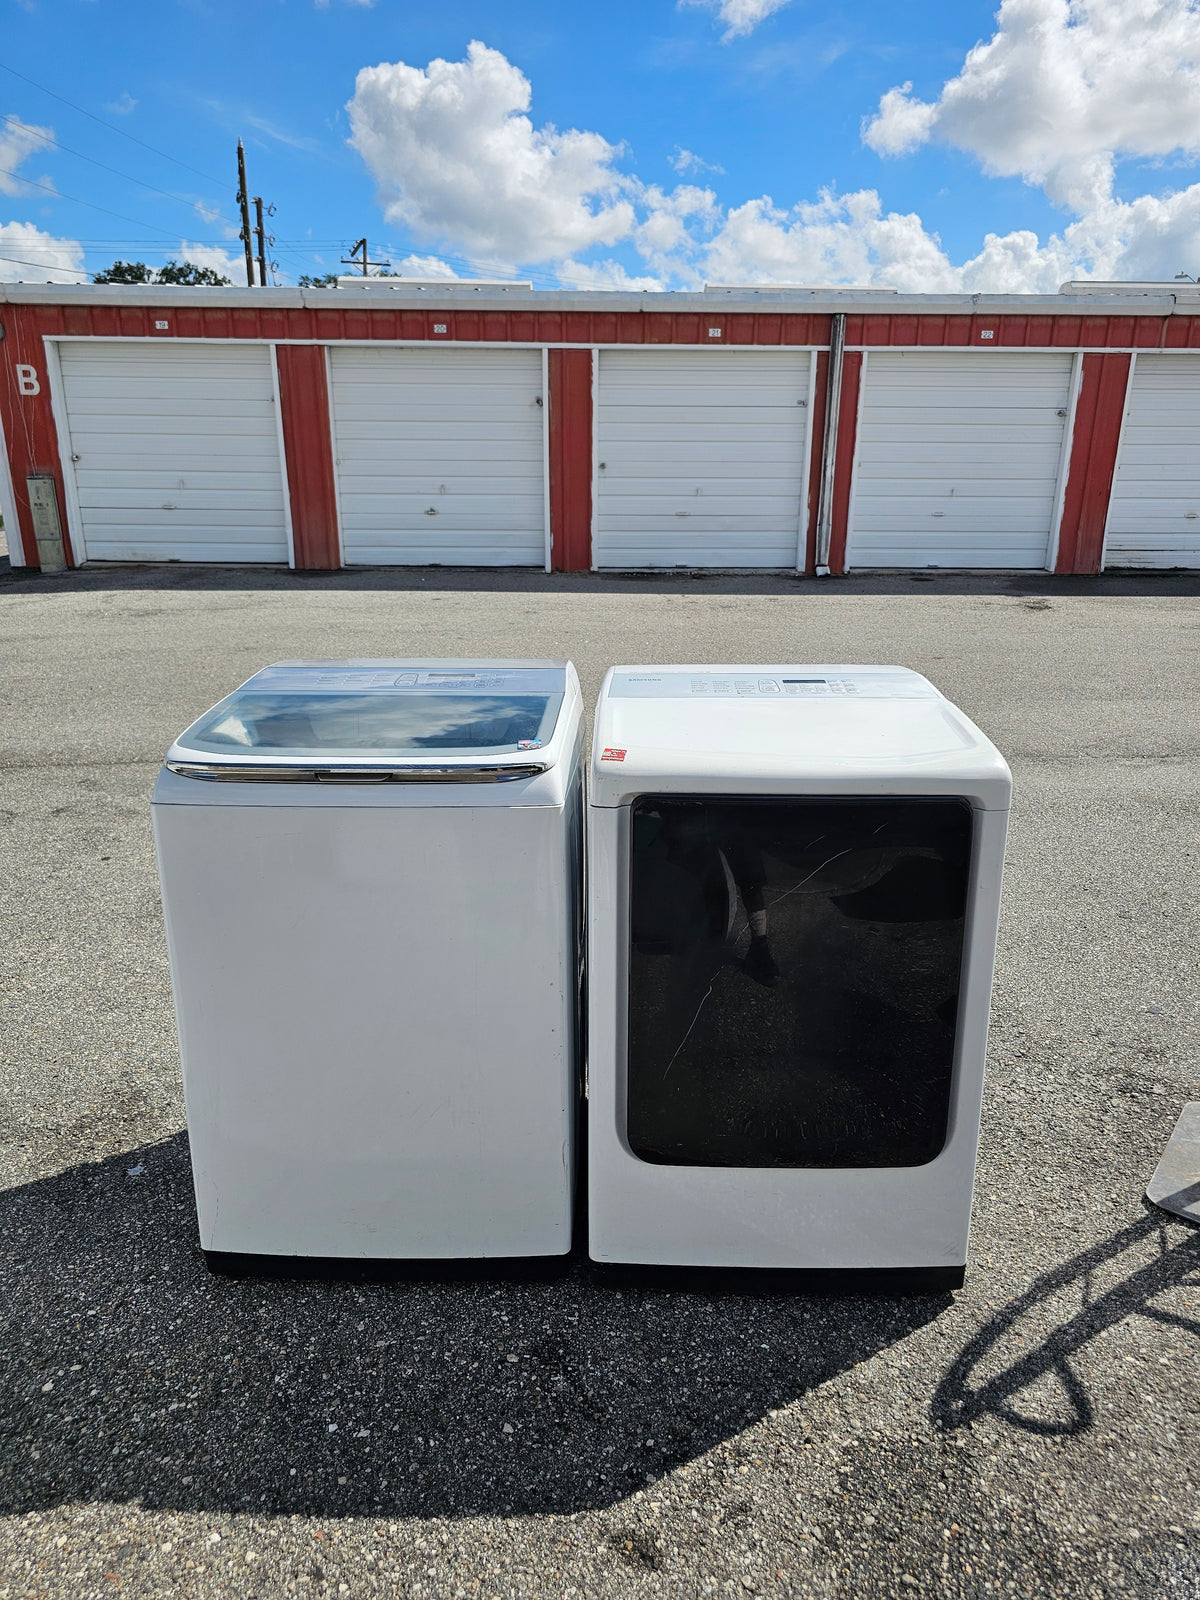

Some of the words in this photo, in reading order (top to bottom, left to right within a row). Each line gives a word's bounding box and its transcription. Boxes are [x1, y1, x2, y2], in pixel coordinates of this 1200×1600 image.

[435, 325, 446, 333] 20
[711, 329, 719, 337] 21
[16, 364, 40, 396] B
